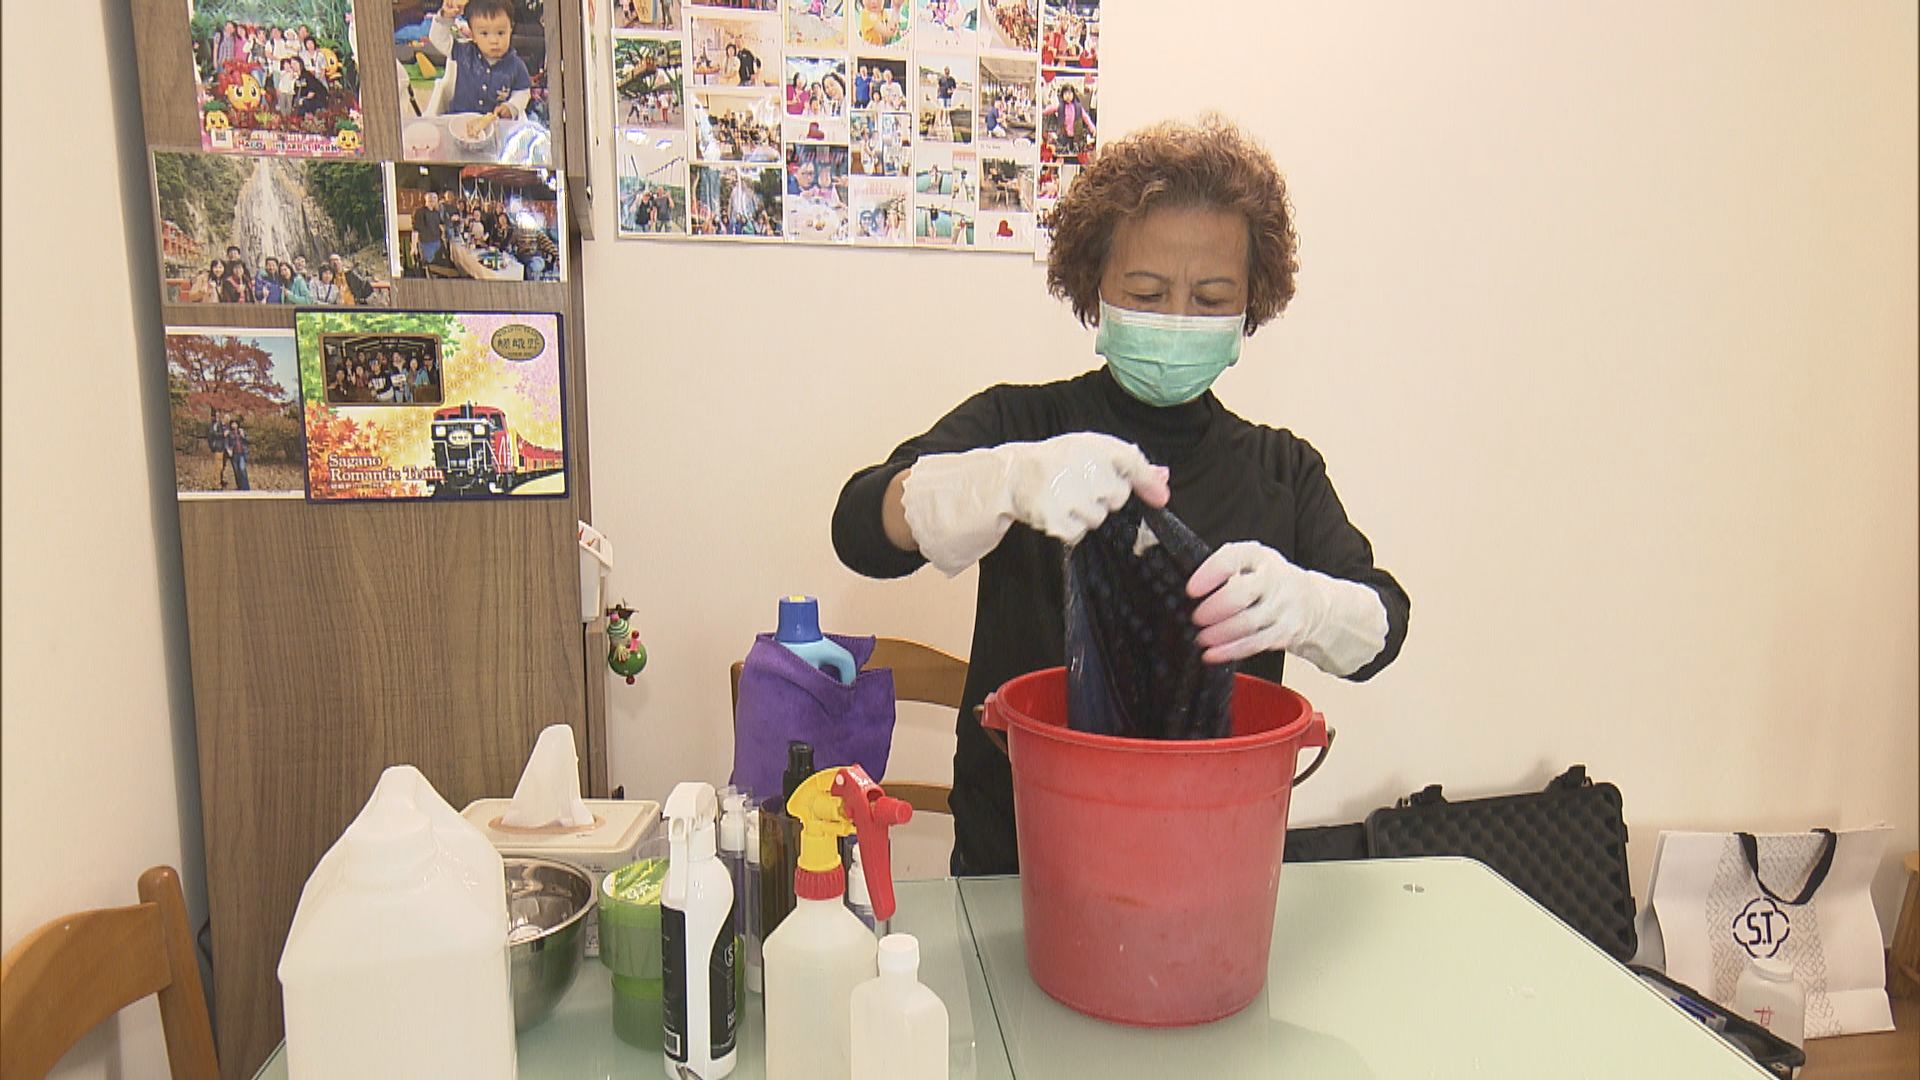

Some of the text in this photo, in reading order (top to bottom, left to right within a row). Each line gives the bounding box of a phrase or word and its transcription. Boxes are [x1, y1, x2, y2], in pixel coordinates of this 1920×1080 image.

[329, 454, 382, 468] Sagano
[330, 464, 445, 481] Romantic Train
